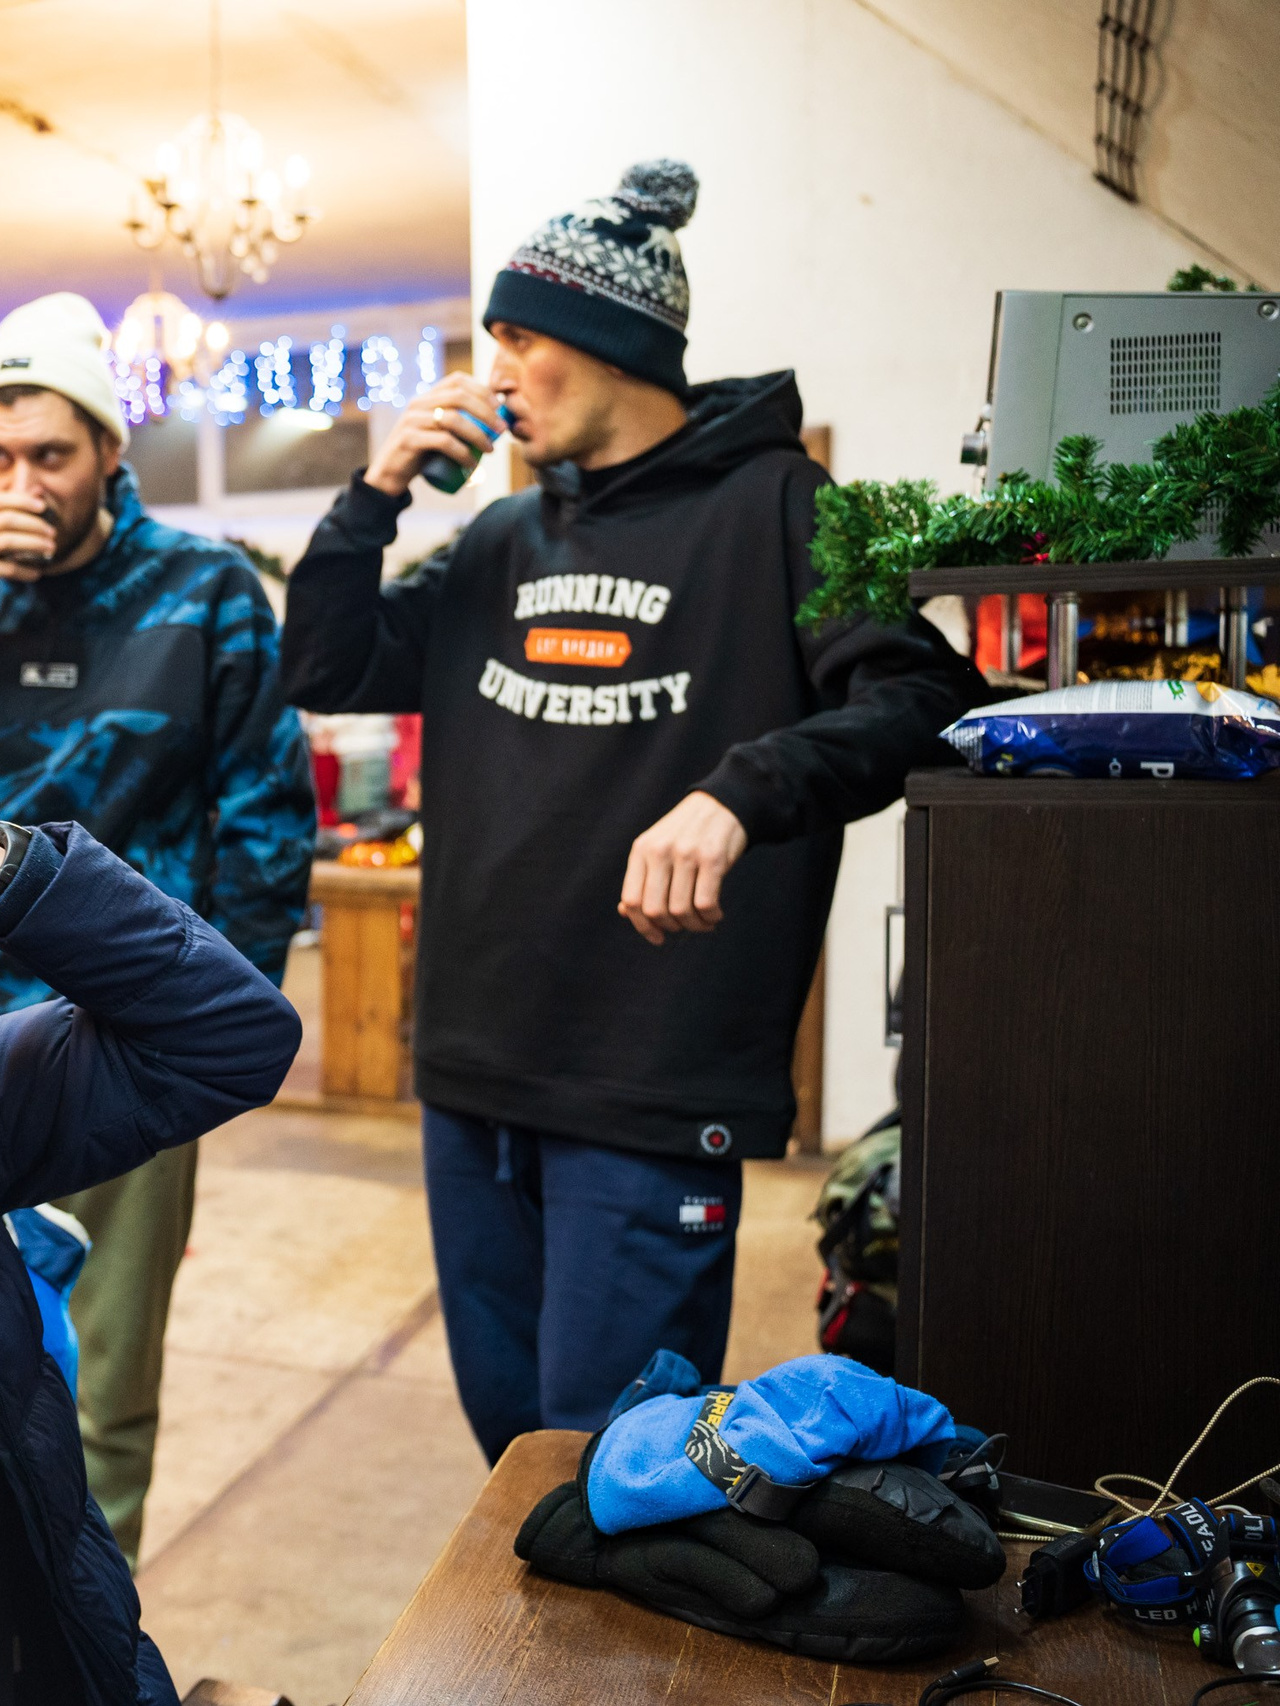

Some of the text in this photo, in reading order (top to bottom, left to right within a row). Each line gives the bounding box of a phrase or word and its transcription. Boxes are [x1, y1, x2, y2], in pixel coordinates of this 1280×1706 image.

[514, 574, 671, 624] RUNNING
[478, 658, 691, 725] UNIVERSITY
[1134, 1608, 1177, 1620] LED
